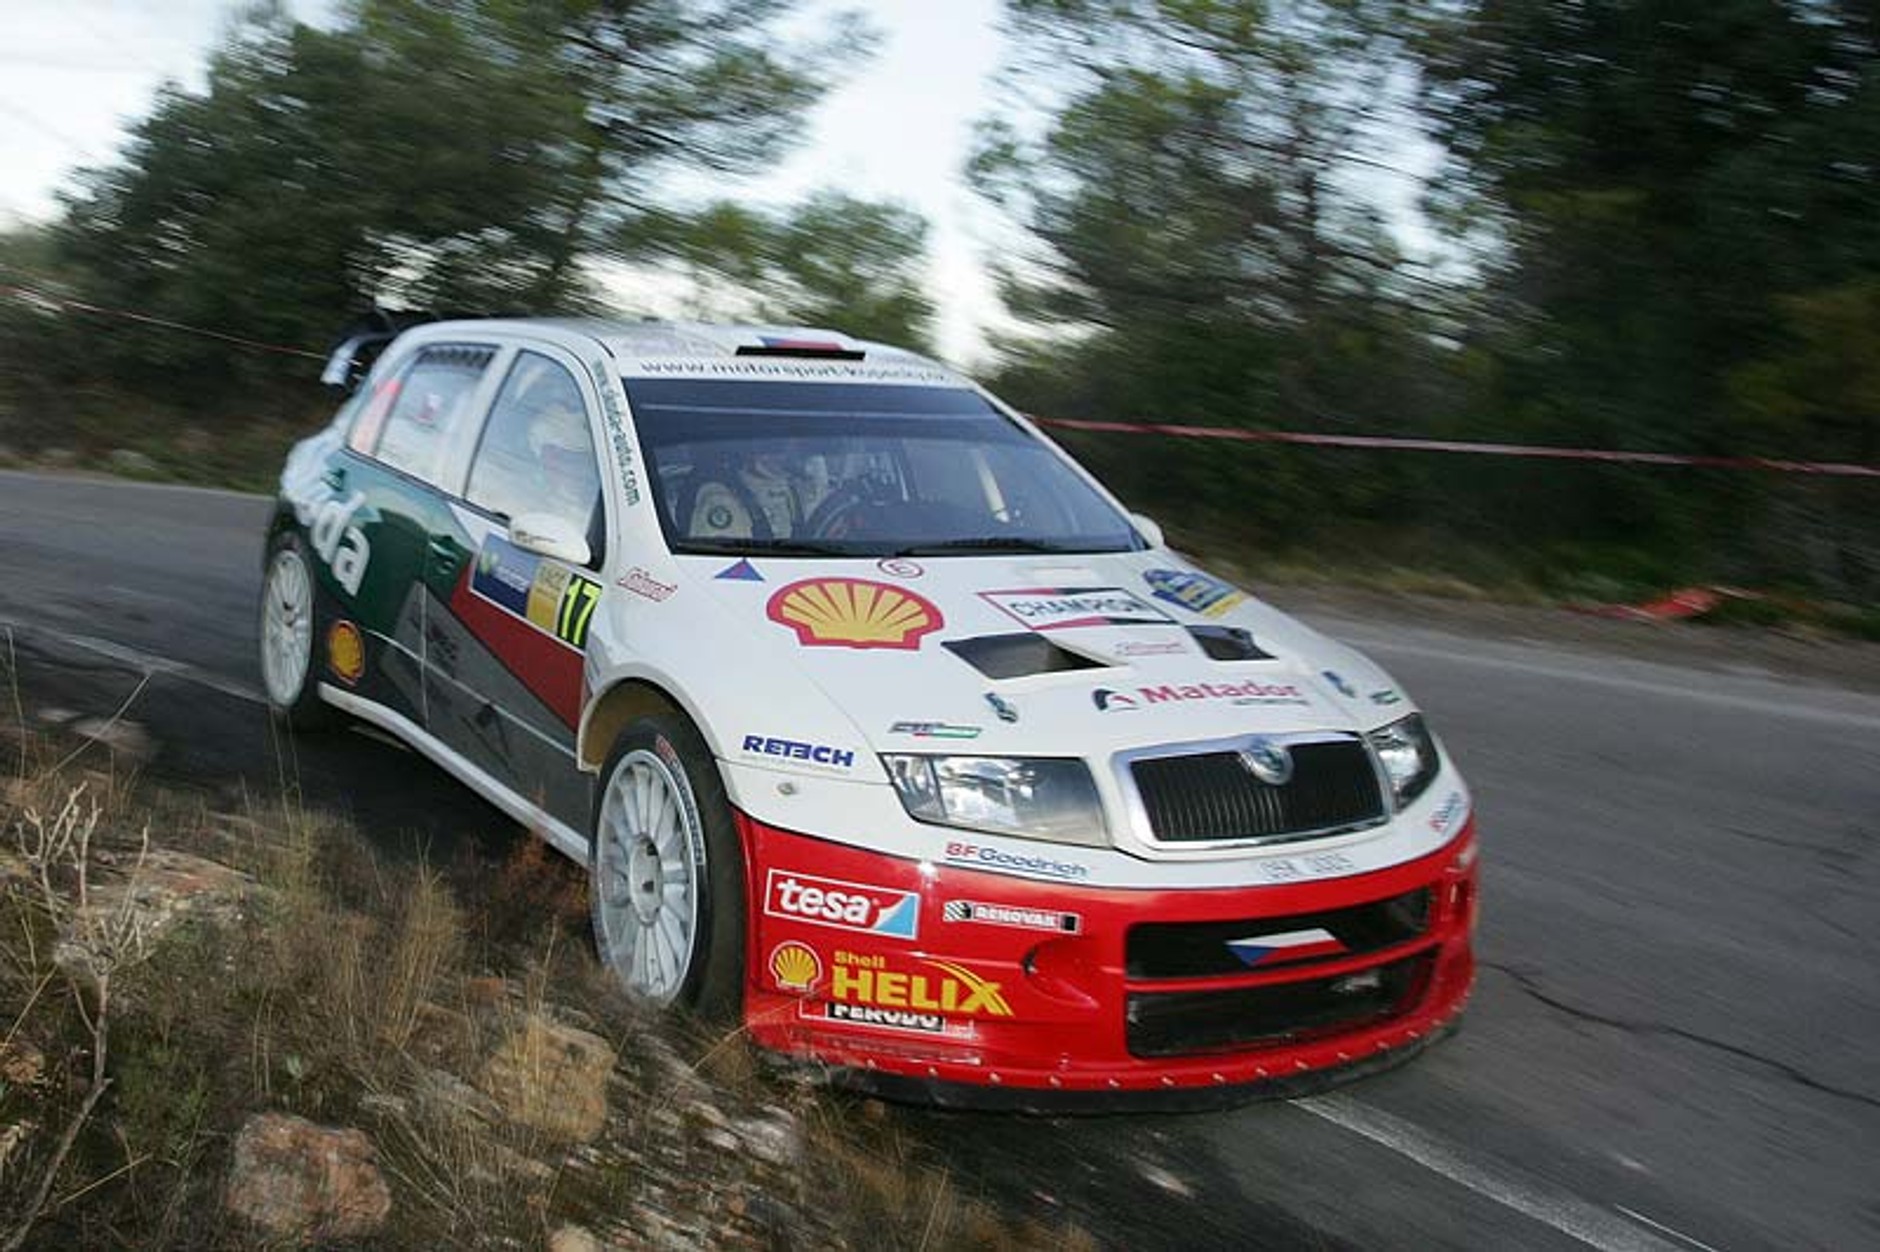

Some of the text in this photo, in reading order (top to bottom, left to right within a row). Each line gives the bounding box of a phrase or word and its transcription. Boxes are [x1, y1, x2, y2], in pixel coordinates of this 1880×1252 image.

[561, 576, 602, 645] 17
[1136, 680, 1303, 704] Matador
[945, 842, 1089, 876] BFGoodrich
[776, 878, 871, 924] tesa
[834, 951, 885, 967] Shell
[831, 961, 1014, 1017] HELIX
